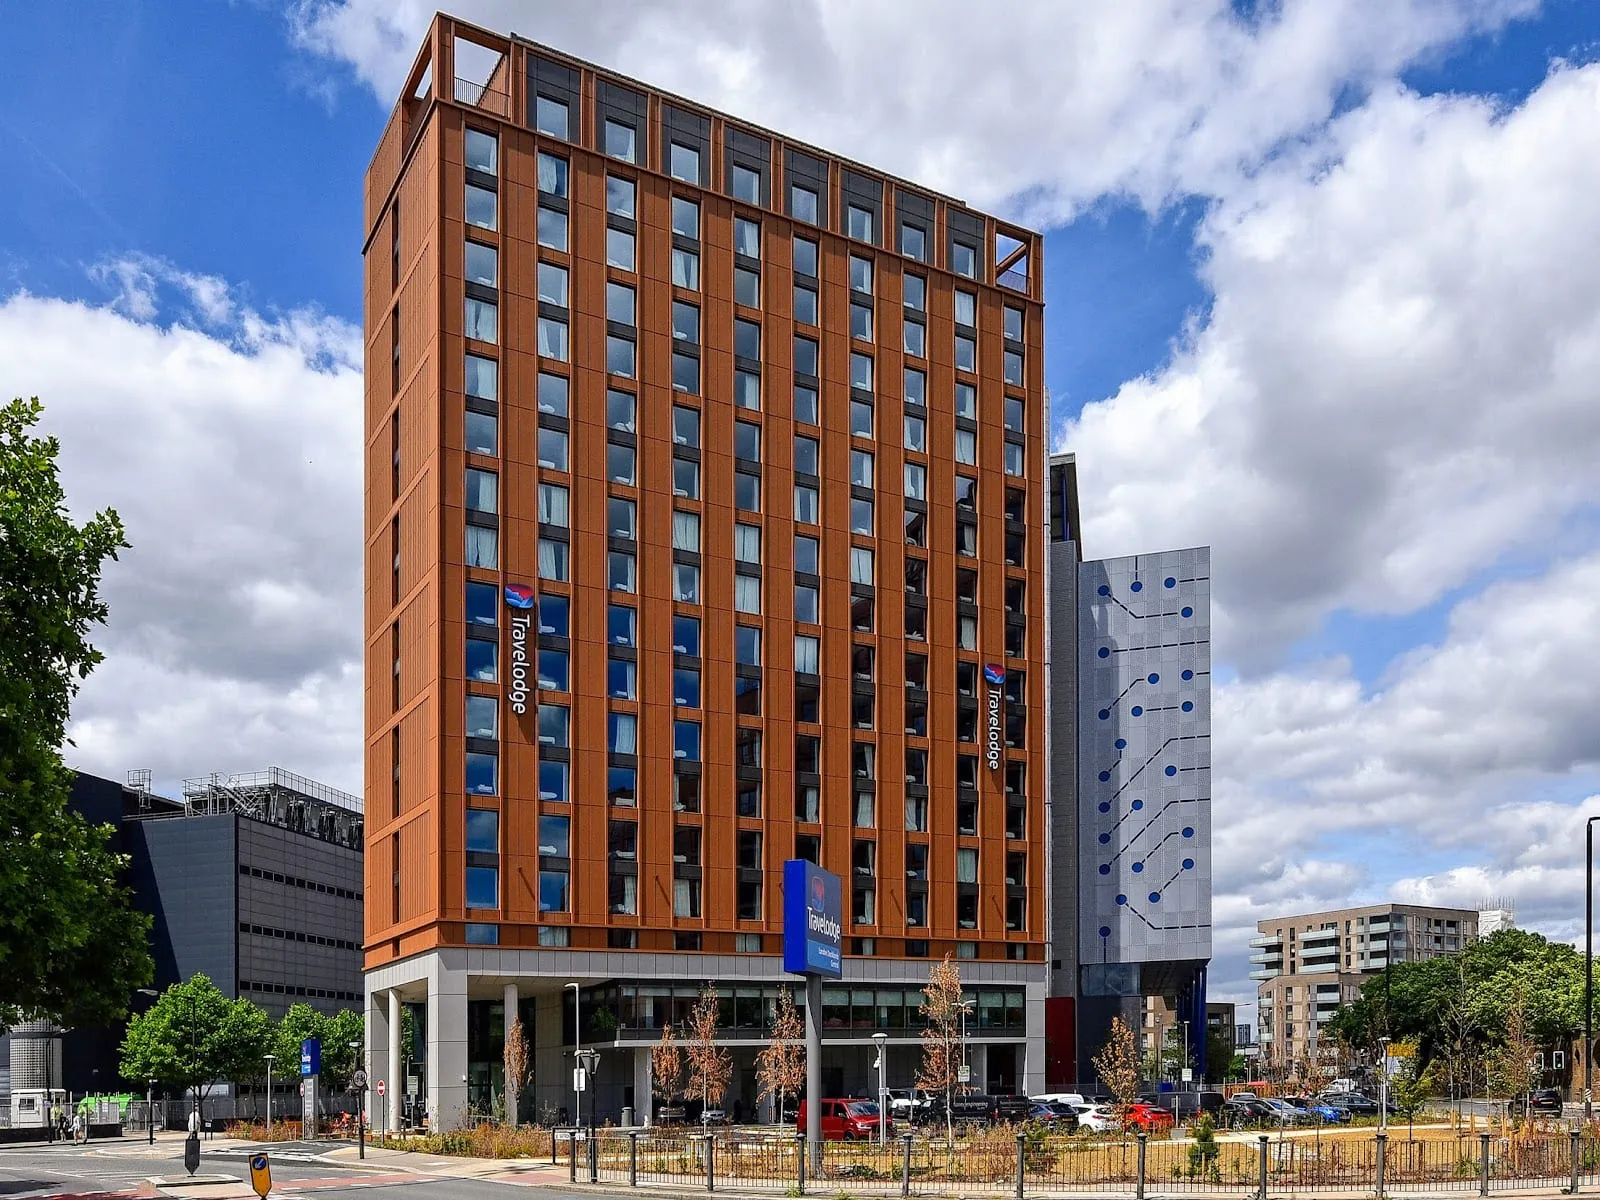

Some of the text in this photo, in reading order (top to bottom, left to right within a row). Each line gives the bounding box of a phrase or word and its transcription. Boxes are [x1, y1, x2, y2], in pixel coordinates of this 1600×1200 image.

[509, 614, 530, 714] Travelodge
[987, 688, 1002, 770] Travelodge
[807, 906, 840, 943] Travelodge
